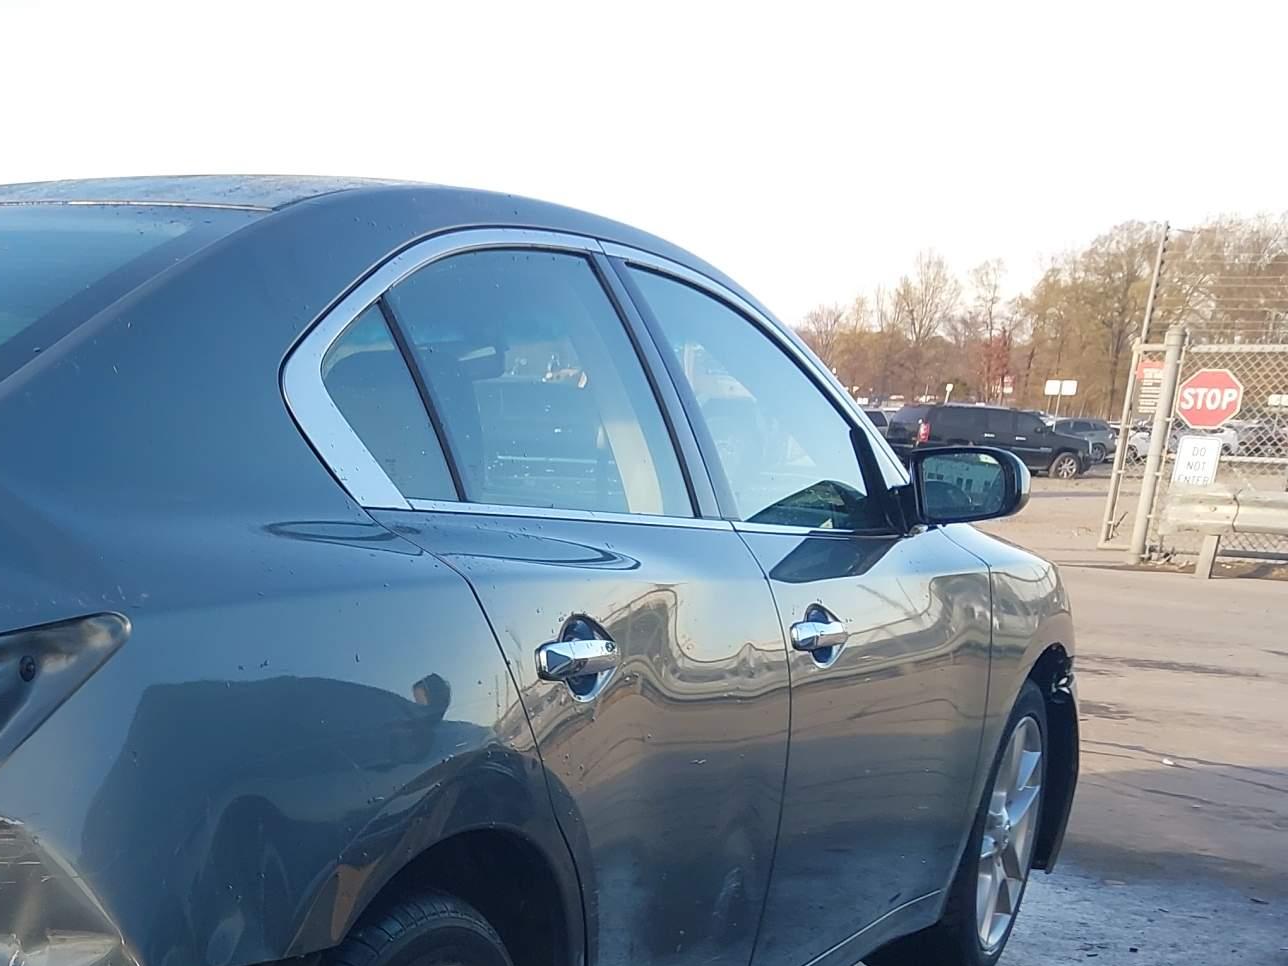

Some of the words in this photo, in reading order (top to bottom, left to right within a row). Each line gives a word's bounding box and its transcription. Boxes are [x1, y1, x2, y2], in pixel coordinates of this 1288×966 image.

[1180, 387, 1238, 410] STOP
[1192, 446, 1207, 457] DO
[1185, 461, 1207, 471] NOT
